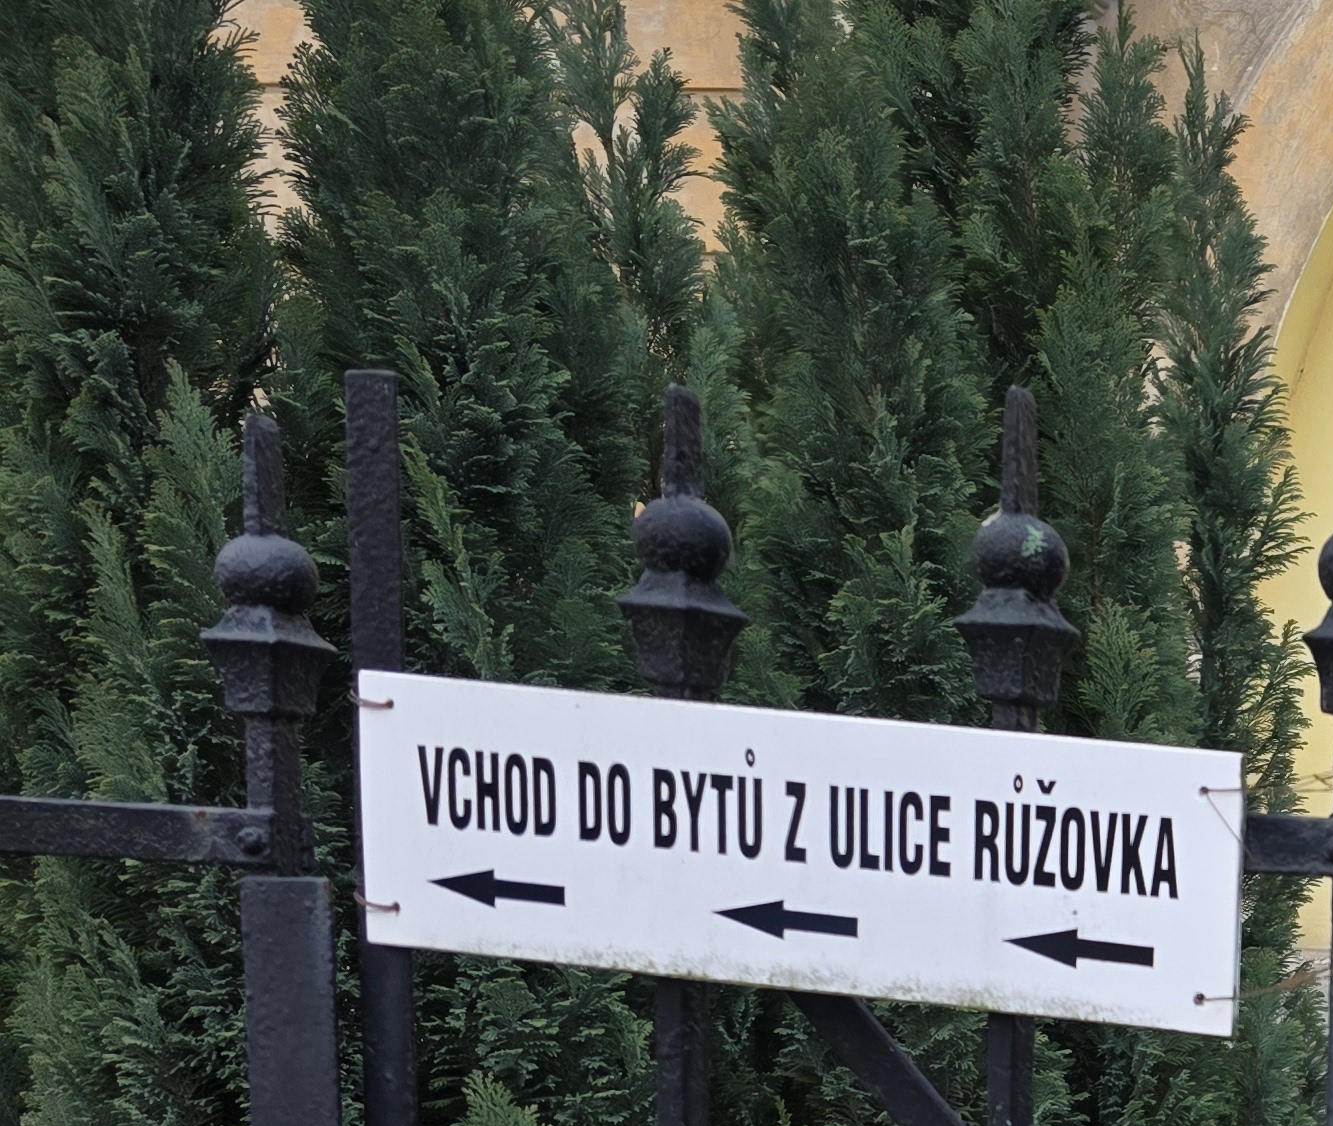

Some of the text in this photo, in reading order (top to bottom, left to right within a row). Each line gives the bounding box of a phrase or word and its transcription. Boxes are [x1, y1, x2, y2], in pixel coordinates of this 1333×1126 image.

[417, 744, 1179, 899] VCHOD DO BYTŮ Z ULICE RŮŽOVKA
